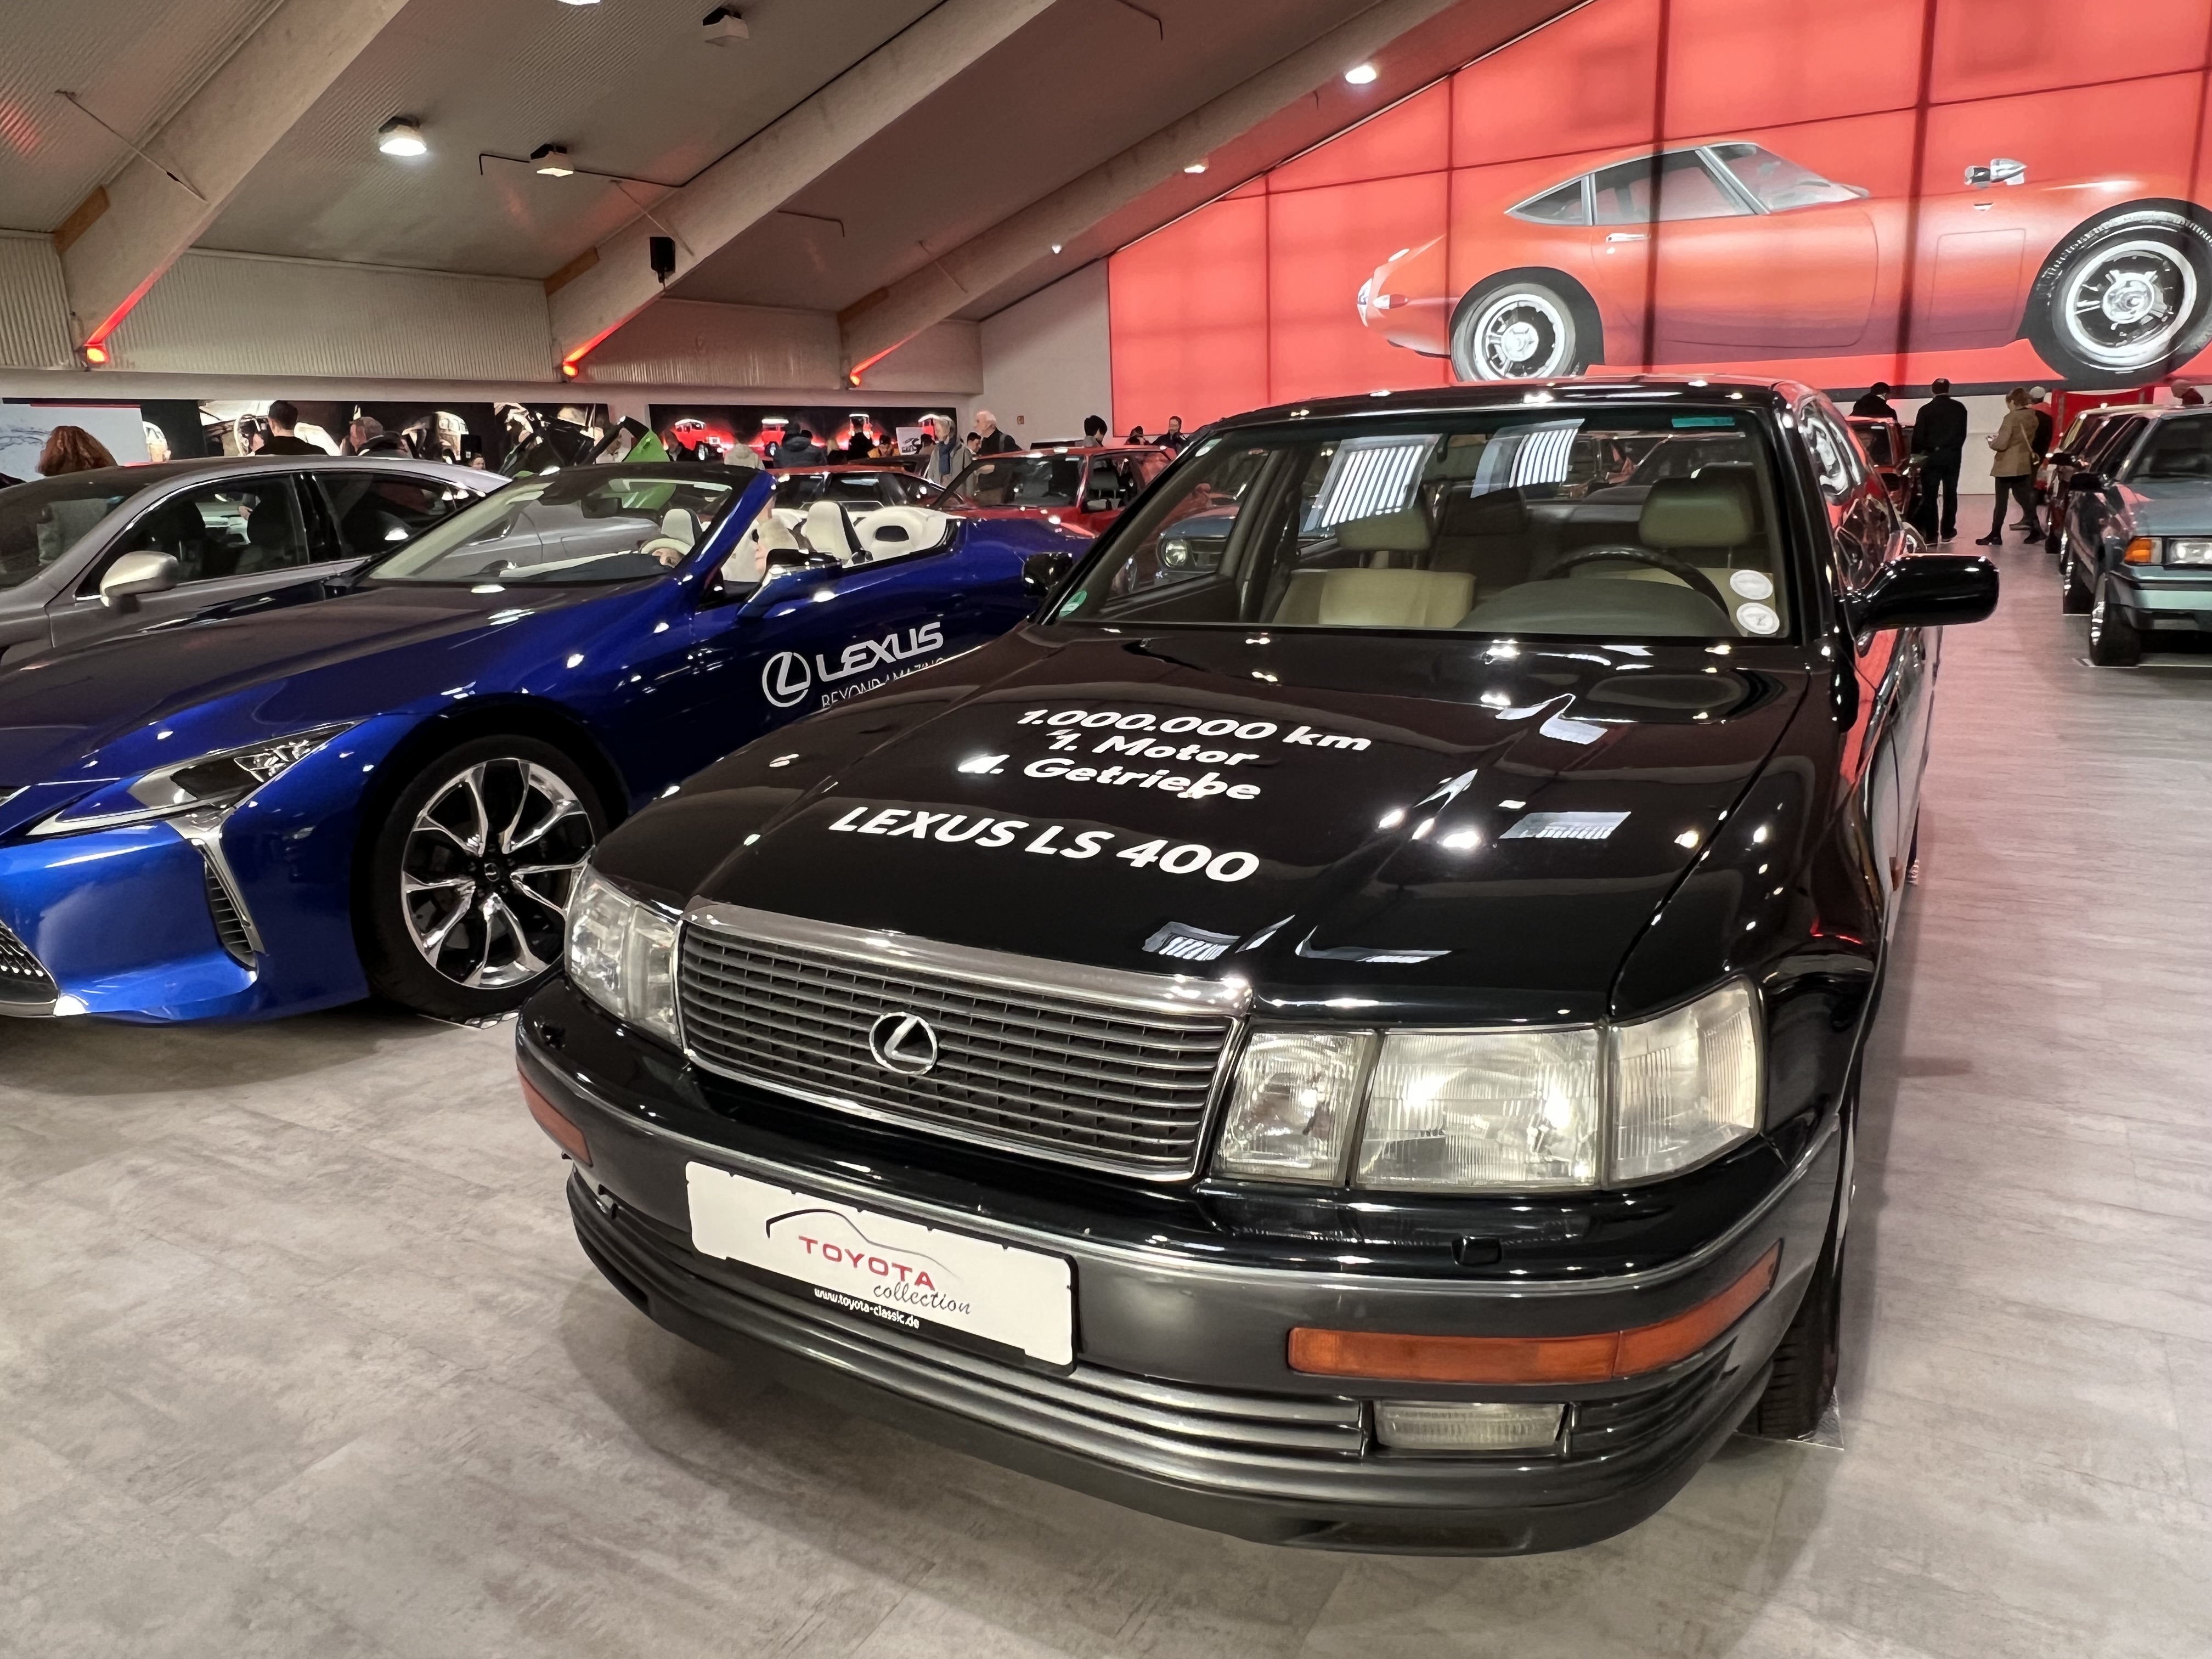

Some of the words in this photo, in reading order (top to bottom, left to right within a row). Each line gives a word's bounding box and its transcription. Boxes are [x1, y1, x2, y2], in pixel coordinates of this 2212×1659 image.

[816, 622, 943, 682] LEXUS
[1017, 709, 1278, 739] 1.000.000
[1282, 725, 1372, 751] km
[1048, 733, 1081, 751] 1.
[1092, 736, 1260, 765] Motor
[1024, 758, 1261, 799] Getriebe
[828, 806, 1030, 847] LEXUS
[1025, 825, 1115, 859] LS
[1116, 839, 1260, 882] 400
[798, 1235, 935, 1291] TOYOTA
[814, 1288, 919, 1329] www.toyota-classic.de
[873, 1282, 970, 1314] collection
